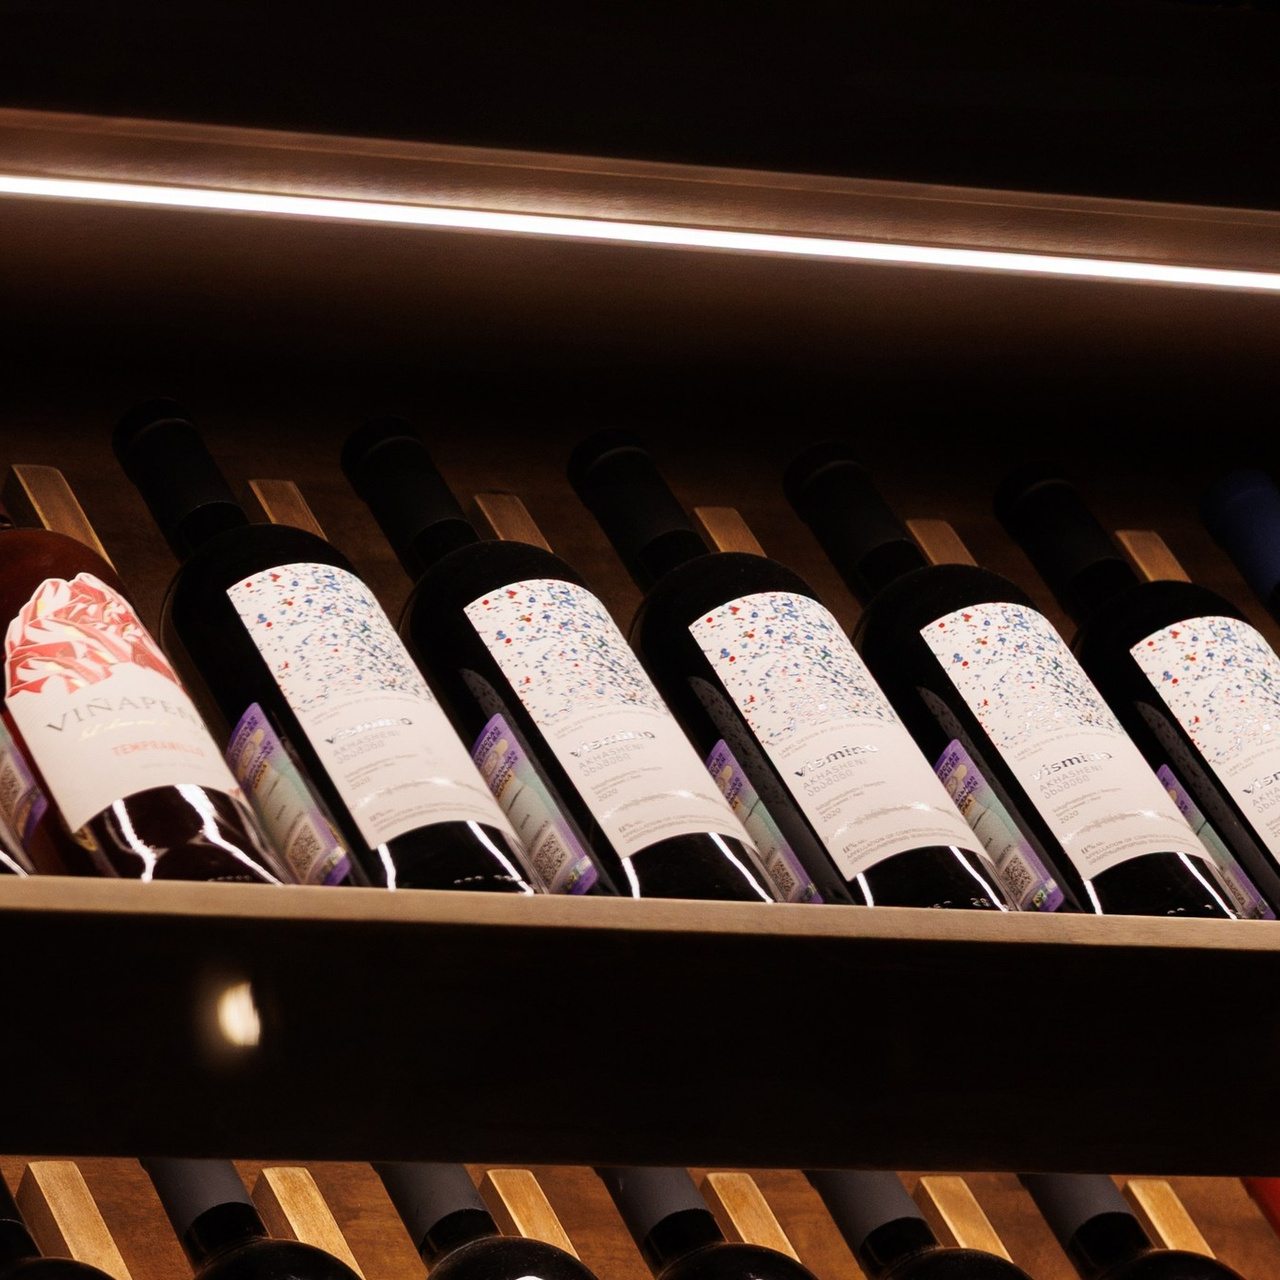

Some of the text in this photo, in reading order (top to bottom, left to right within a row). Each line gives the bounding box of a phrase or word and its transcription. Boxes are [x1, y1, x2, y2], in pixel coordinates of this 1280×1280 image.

[579, 743, 644, 770] AKHASHENI
[794, 744, 880, 778] vismino
[1029, 751, 1114, 781] vismino
[803, 758, 868, 790] AKHASHENI
[1039, 764, 1104, 792] AKHASHENI
[821, 807, 842, 822] 2020
[1059, 810, 1080, 825] 2020
